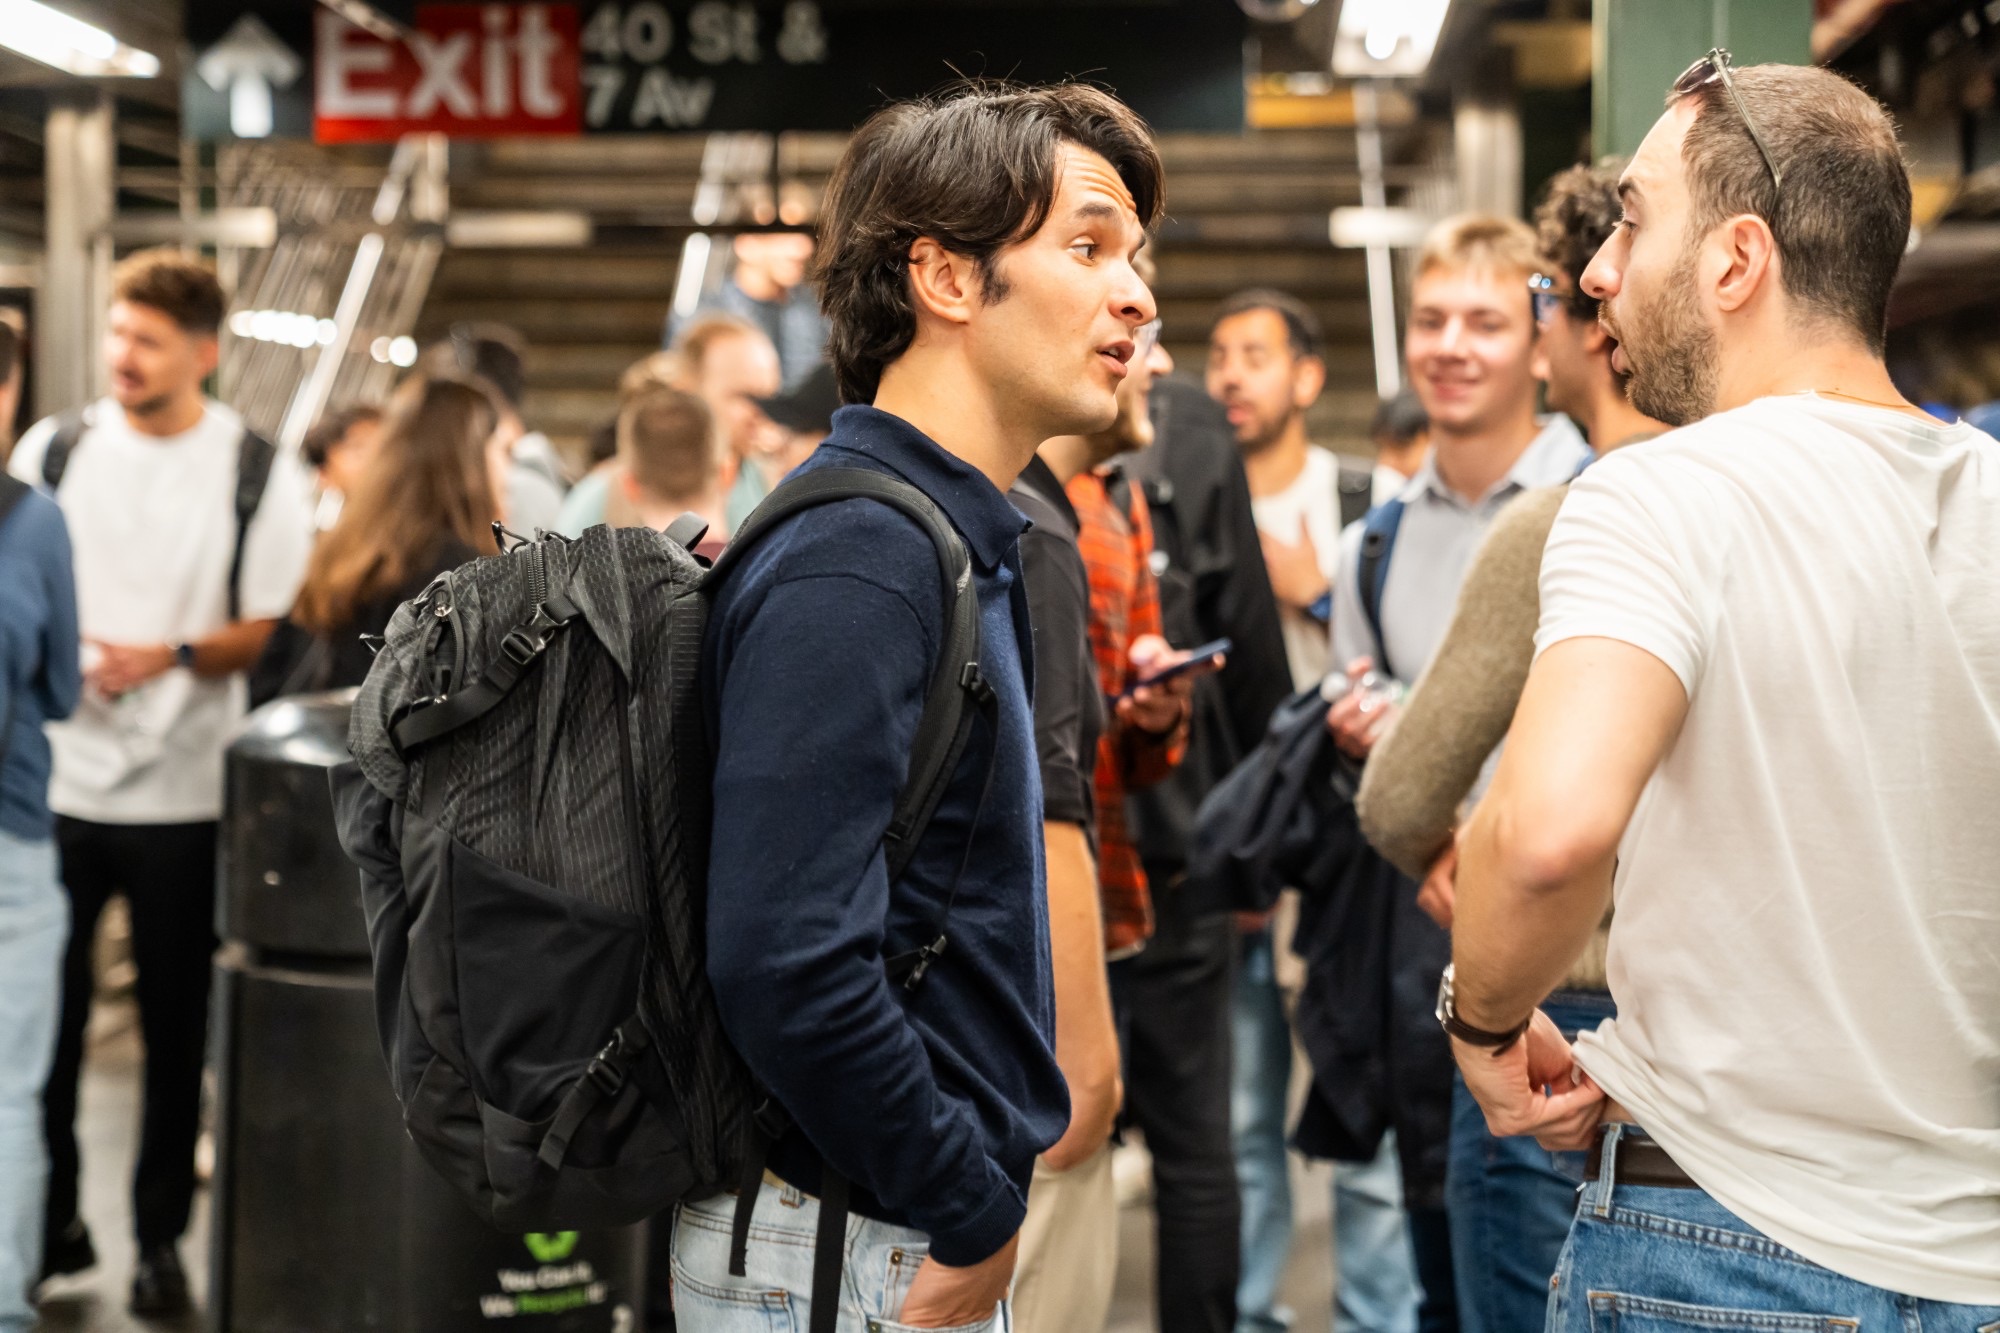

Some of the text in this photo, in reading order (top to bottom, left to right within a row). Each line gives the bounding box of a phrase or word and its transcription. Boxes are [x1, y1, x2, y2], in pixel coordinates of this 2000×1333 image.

[313, 5, 566, 118] Exit
[581, 3, 829, 63] 40 St &
[583, 66, 716, 127] 7 Av
